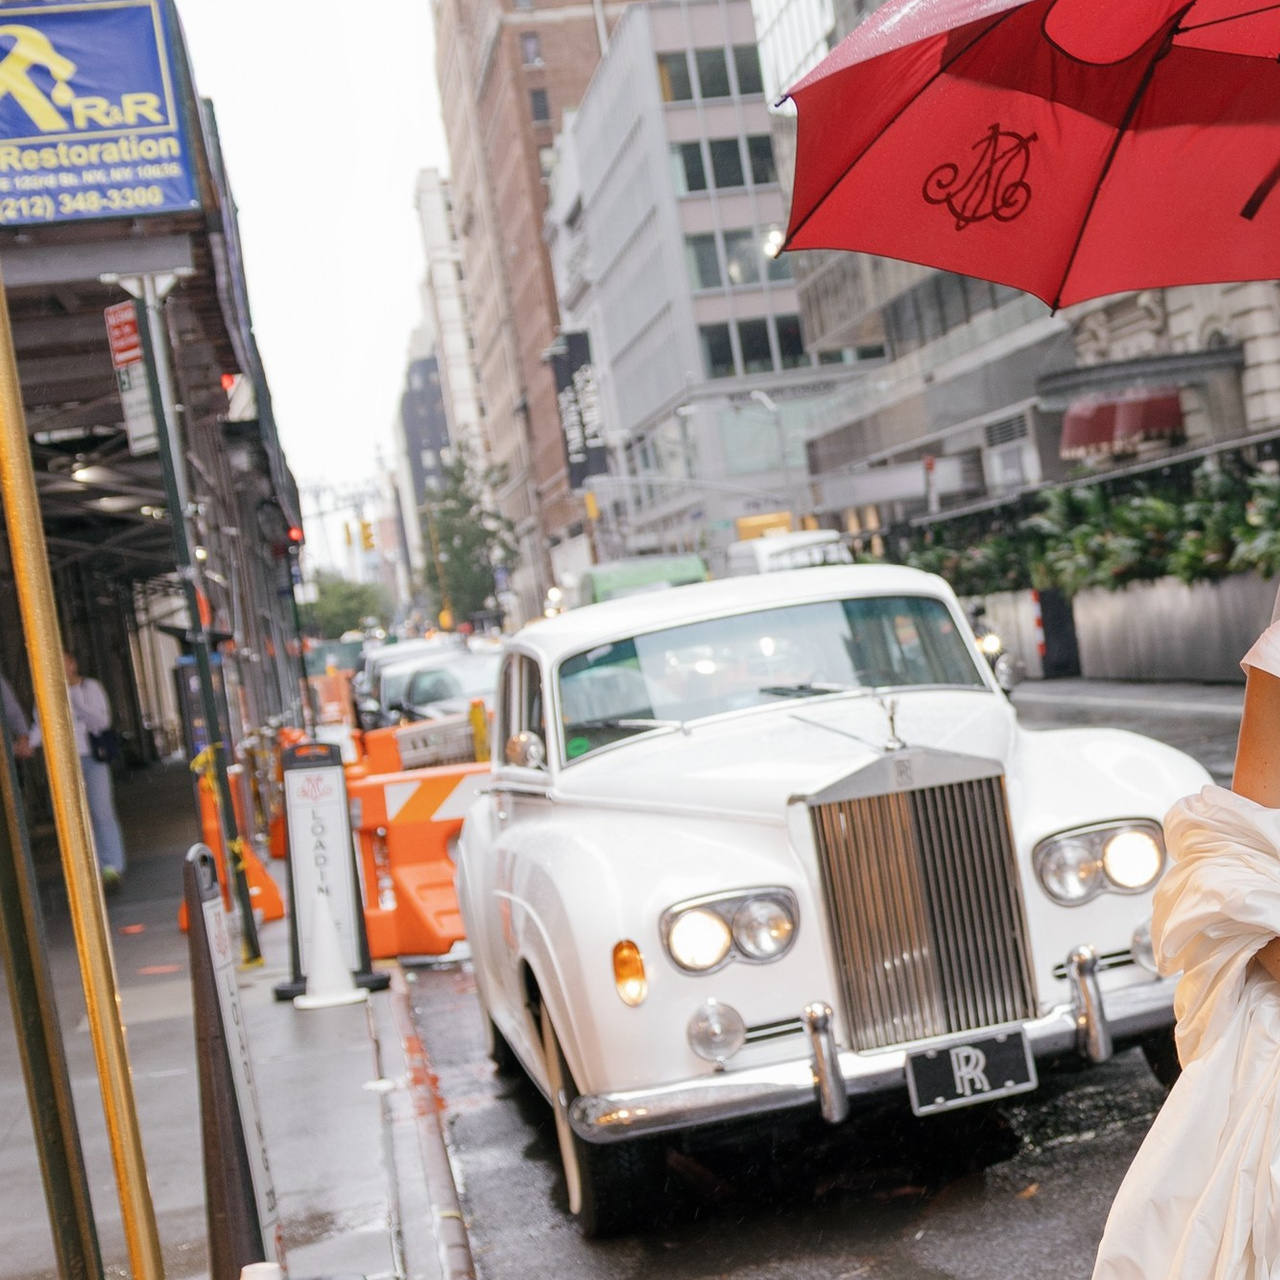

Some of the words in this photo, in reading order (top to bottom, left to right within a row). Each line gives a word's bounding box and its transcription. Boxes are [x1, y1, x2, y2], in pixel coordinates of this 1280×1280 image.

[71, 92, 164, 129] R&R
[0, 135, 180, 171] Restoration
[311, 809, 331, 897] LOADIN
